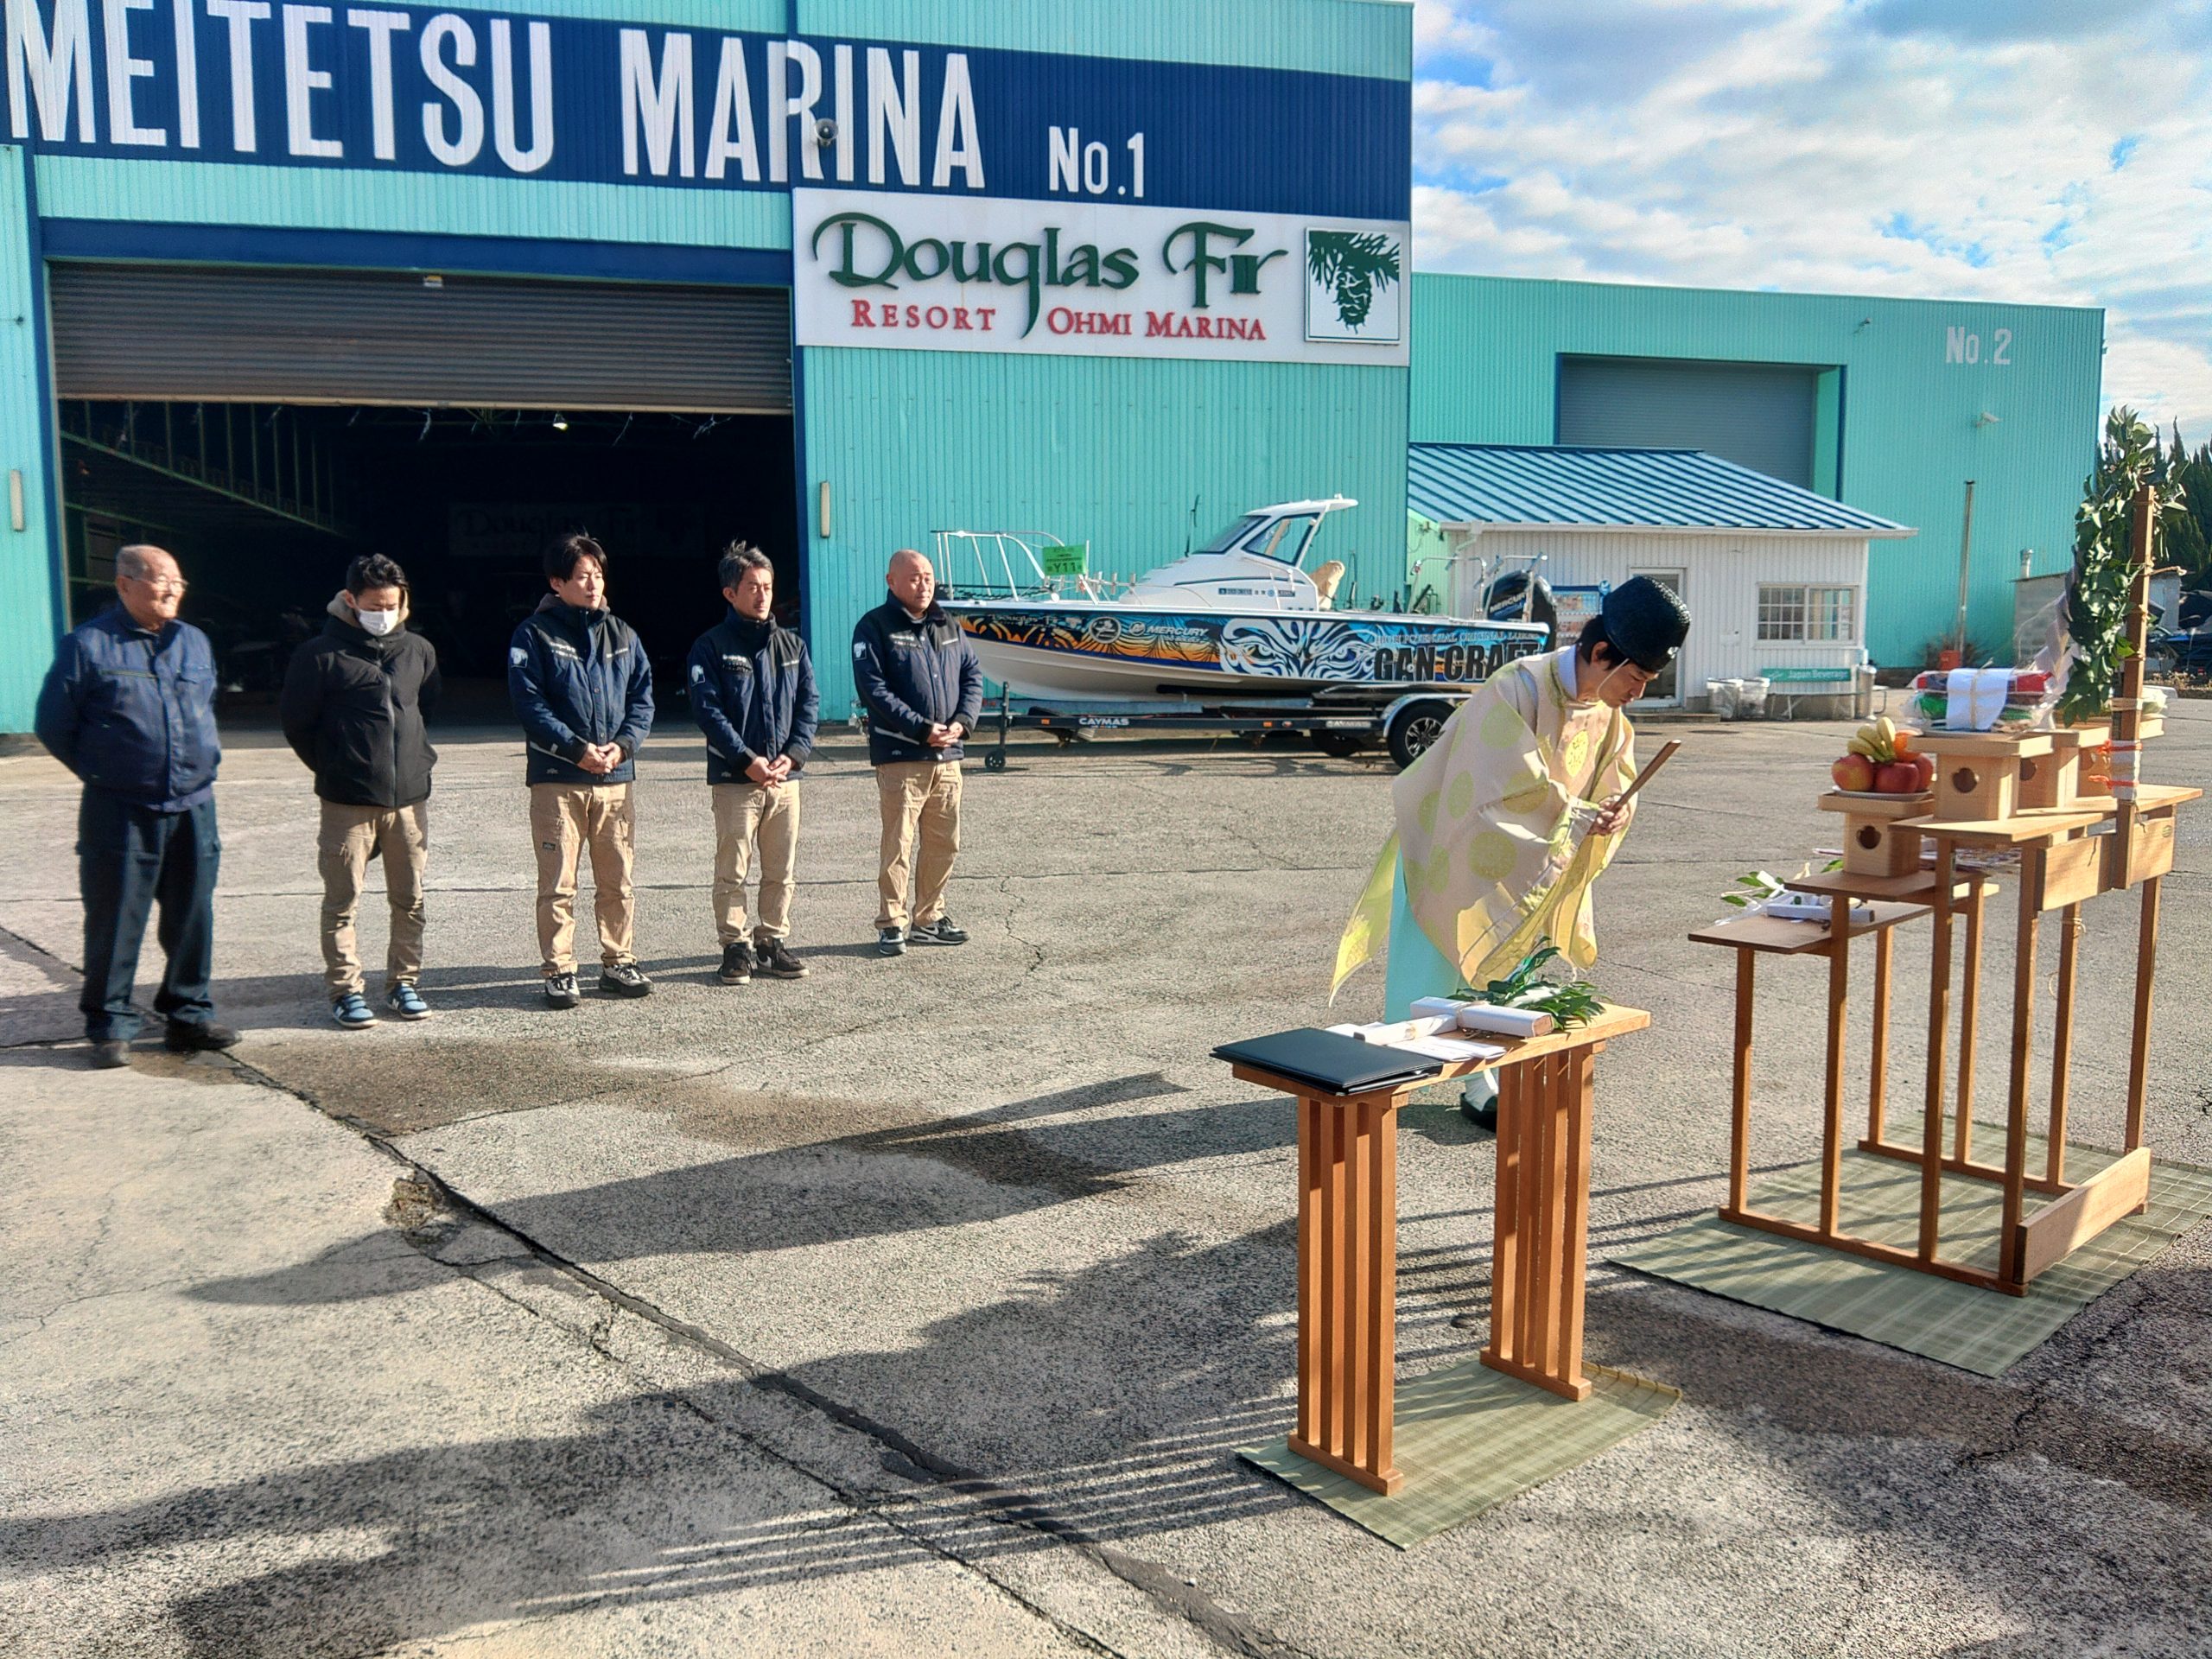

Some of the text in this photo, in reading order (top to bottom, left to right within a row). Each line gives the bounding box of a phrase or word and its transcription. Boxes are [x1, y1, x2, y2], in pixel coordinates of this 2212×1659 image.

[4, 0, 1145, 198] MEITETSU MARINA No.1
[811, 211, 1289, 340] Douglas Fir
[850, 299, 1268, 341] RESORT OHMI MARINA
[1945, 326, 2012, 365] No.2
[1490, 591, 1526, 613] MERCUR
[1146, 625, 1211, 637] MERCURY
[1373, 645, 1436, 682] GAN
[1078, 717, 1130, 726] CAYMAS
